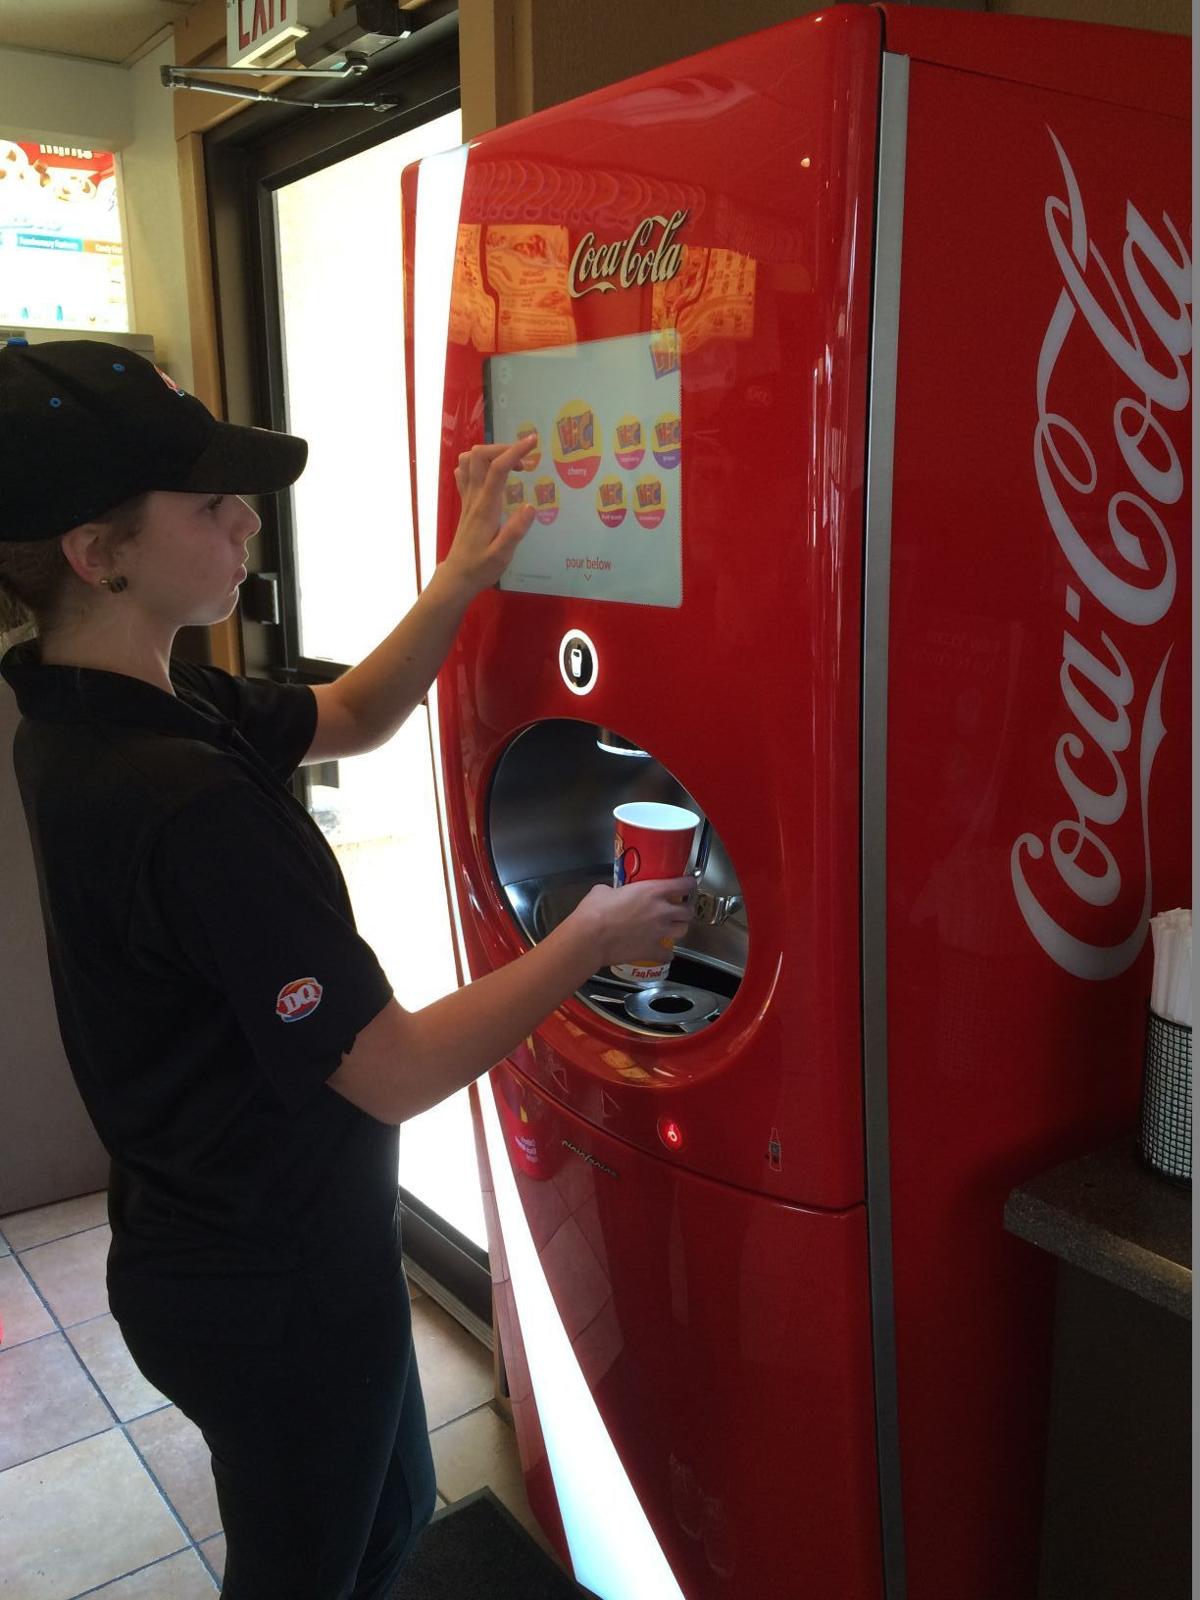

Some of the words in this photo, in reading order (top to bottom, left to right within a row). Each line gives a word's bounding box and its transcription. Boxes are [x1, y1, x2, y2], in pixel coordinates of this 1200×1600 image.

[568, 208, 688, 298] Coca-Cola
[566, 558, 585, 571] pour
[587, 556, 612, 571] below
[1012, 124, 1192, 980] Coca-Cola
[279, 984, 320, 1014] DQ
